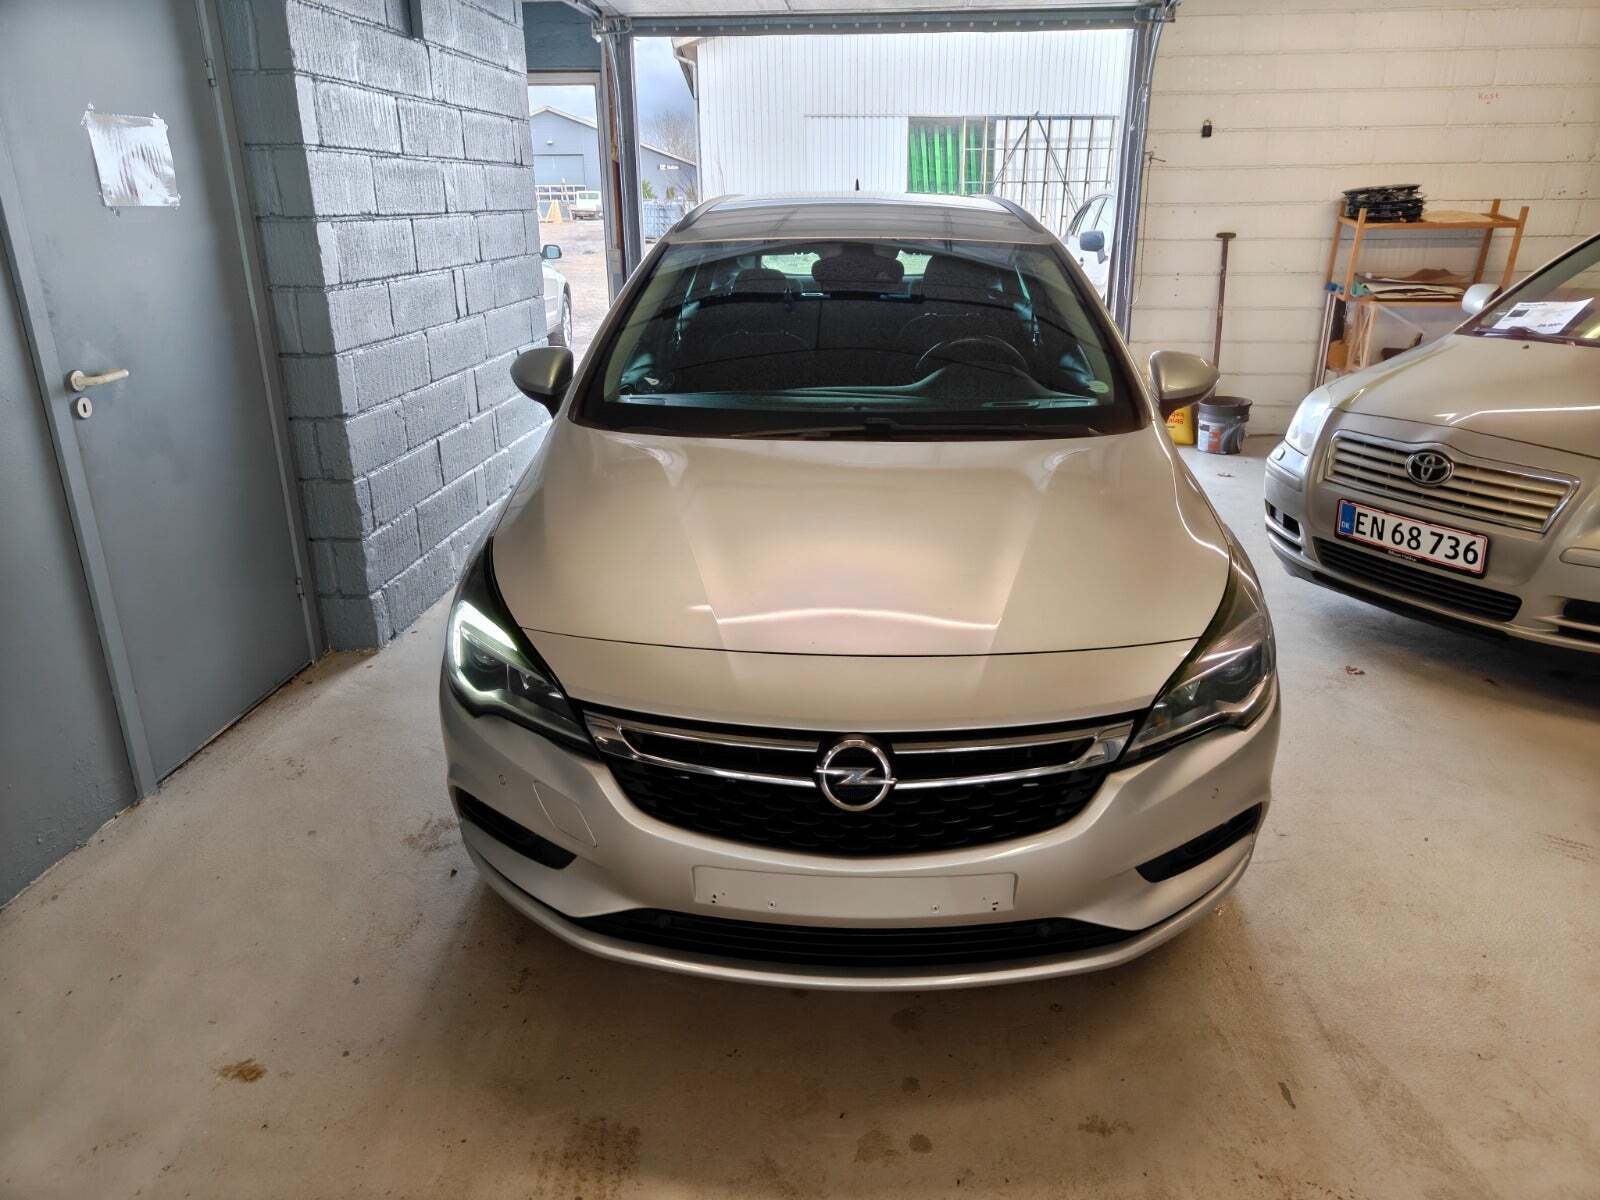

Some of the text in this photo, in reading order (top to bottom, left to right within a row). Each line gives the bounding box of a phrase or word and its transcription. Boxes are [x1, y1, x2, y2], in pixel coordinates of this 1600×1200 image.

[1341, 520, 1350, 529] DK
[1355, 511, 1386, 541] EN
[1391, 522, 1422, 551] 68
[1429, 530, 1479, 565] 736
